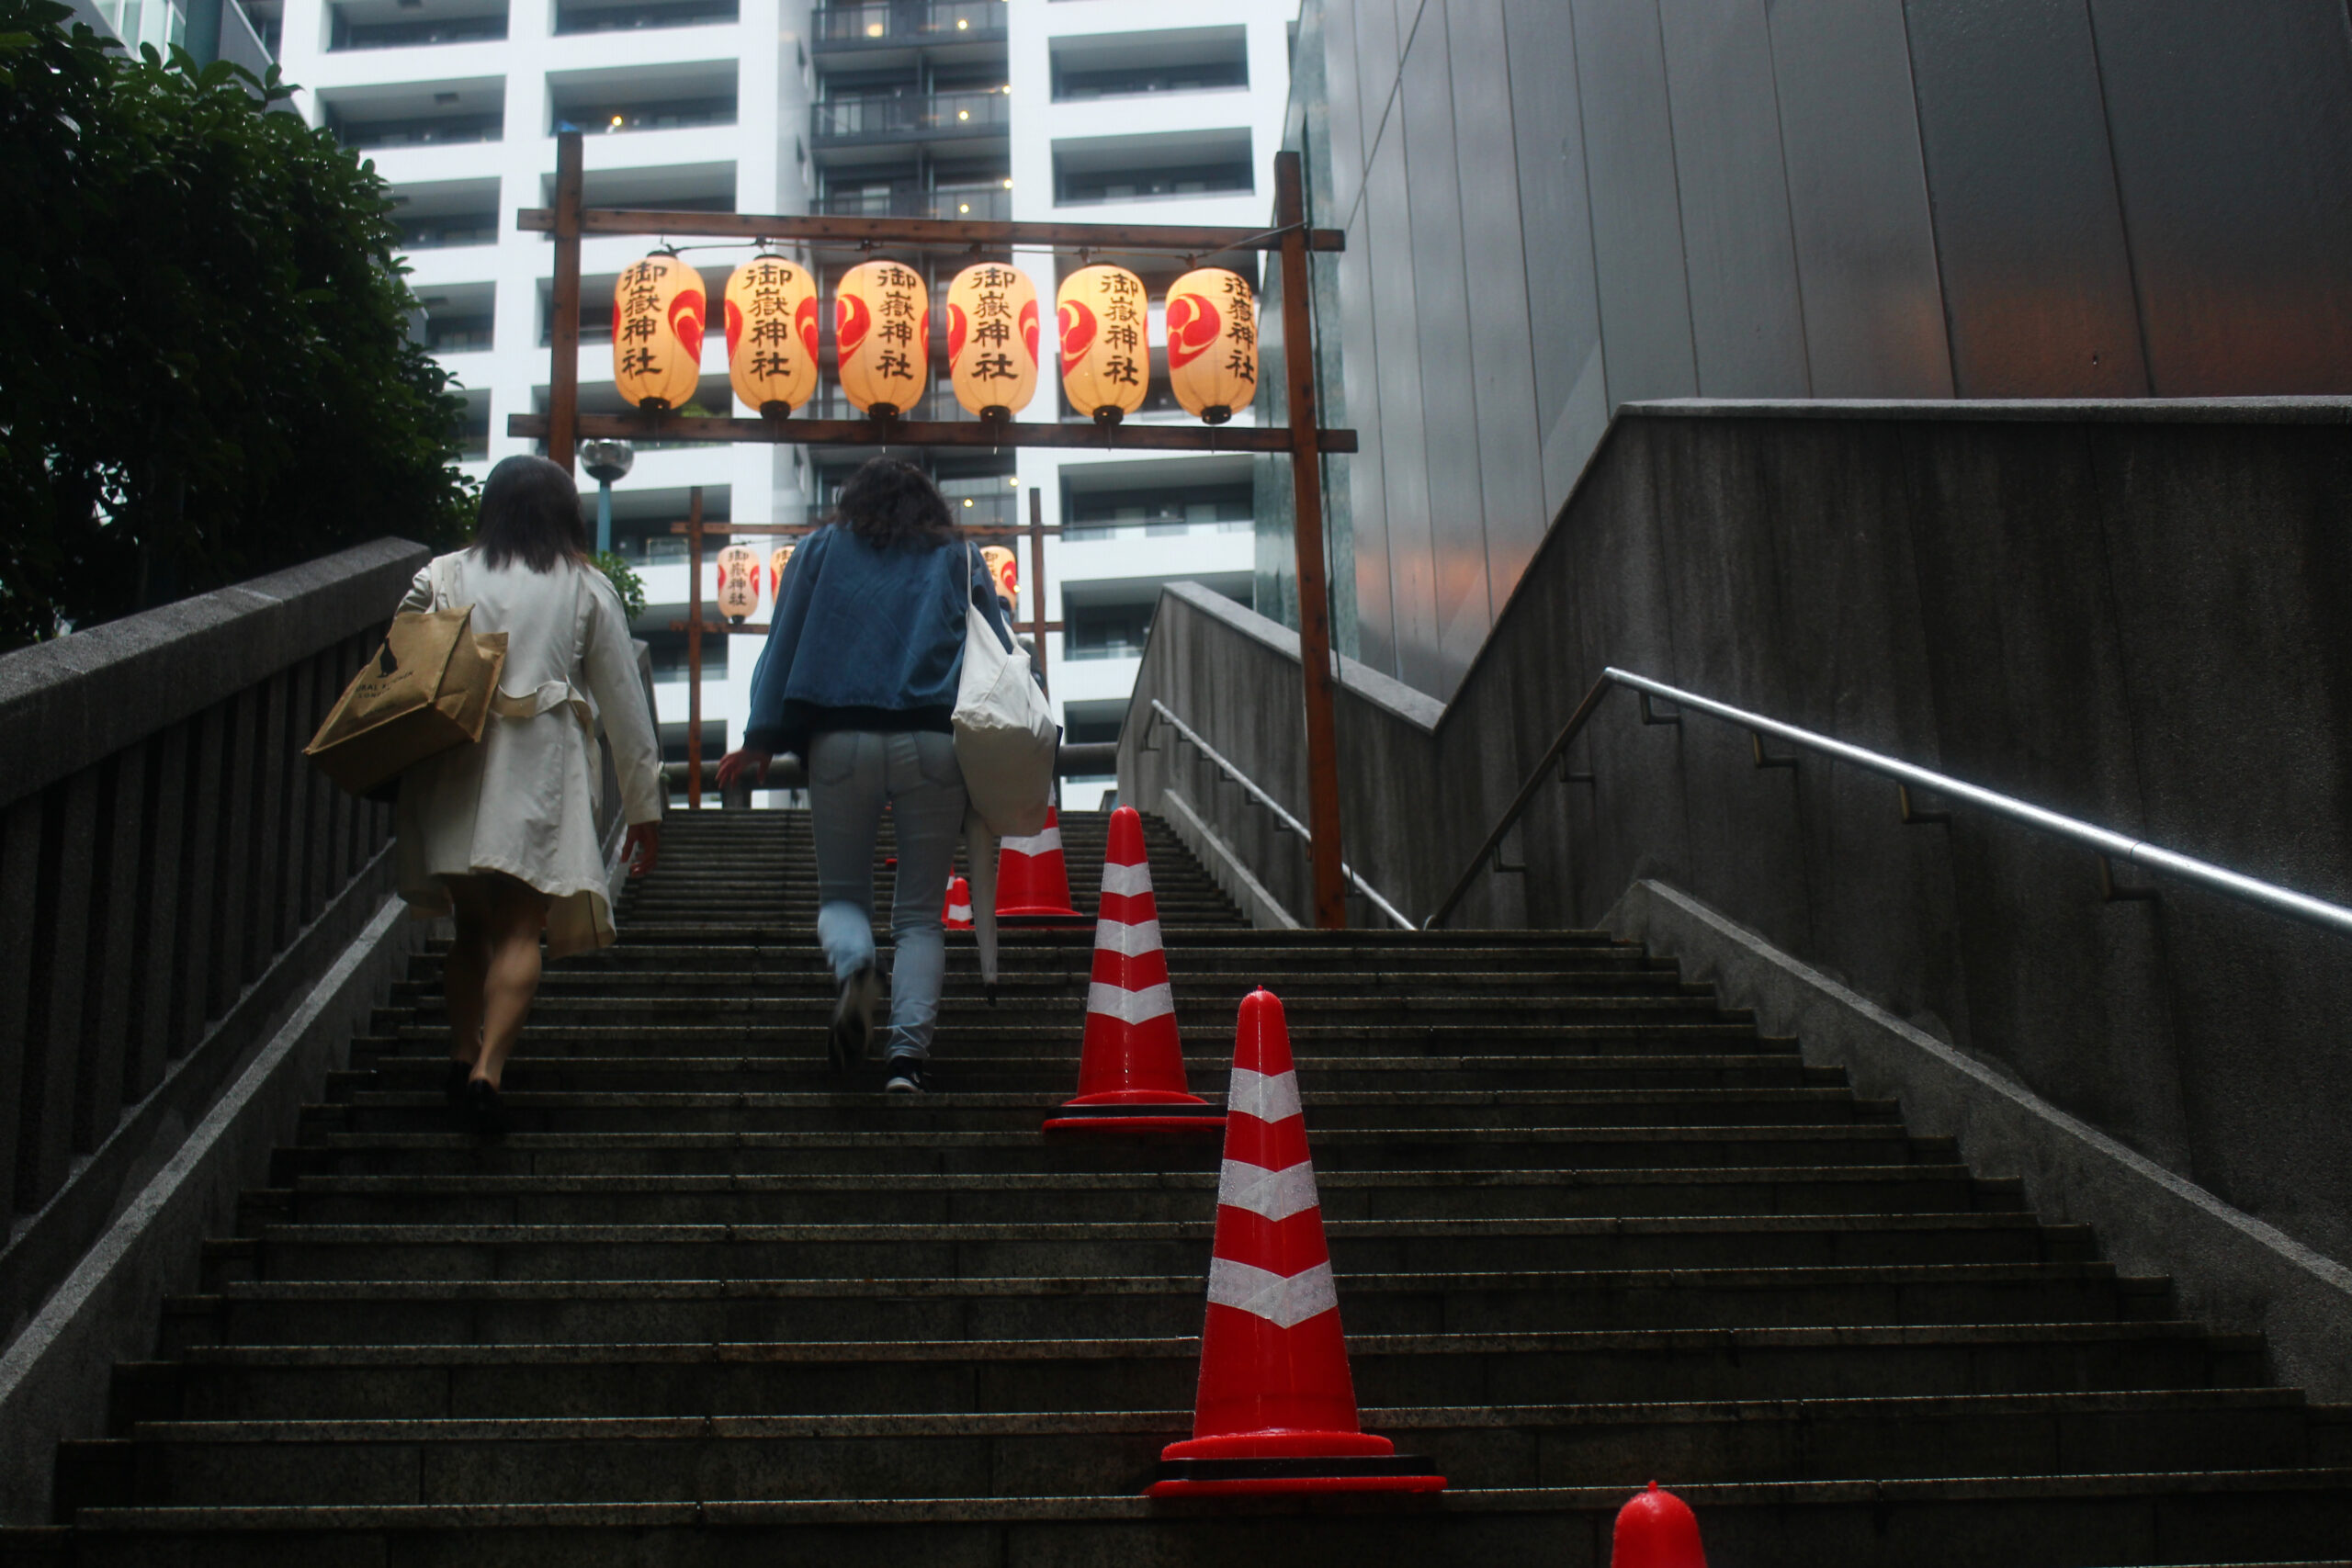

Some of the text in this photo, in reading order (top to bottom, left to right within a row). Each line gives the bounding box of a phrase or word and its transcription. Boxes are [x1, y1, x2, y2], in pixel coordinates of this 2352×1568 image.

[621, 261, 668, 380] 御嶽神社
[742, 264, 793, 382] 御嶽神社
[875, 266, 917, 380] 御嶽神社
[970, 266, 1018, 381] 御嶽神社
[1101, 273, 1140, 386] 御嶽神社
